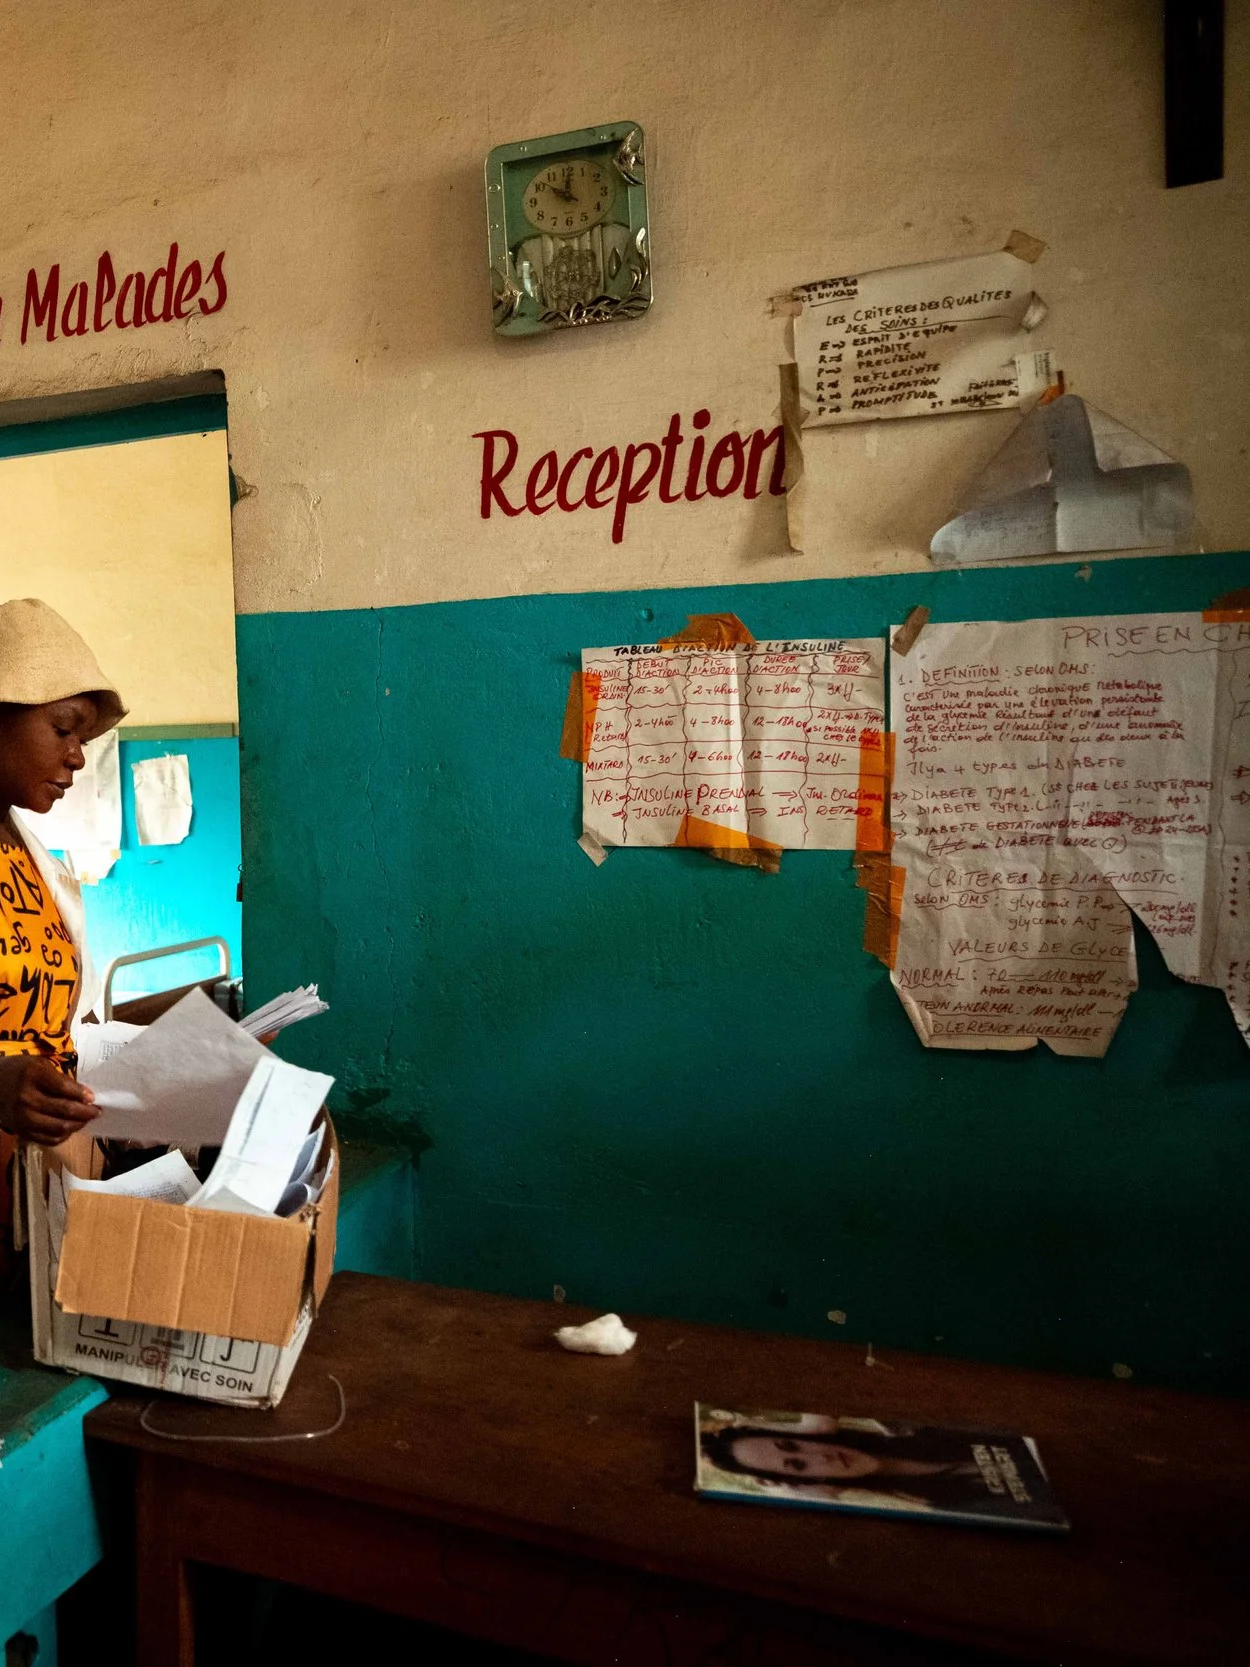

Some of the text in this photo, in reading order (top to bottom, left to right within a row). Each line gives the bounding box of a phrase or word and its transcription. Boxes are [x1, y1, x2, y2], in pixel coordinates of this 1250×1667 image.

[21, 241, 228, 345] Malades
[826, 316, 846, 326] LES
[472, 408, 788, 544] Reception
[614, 646, 662, 656] TABLEAU
[215, 1374, 254, 1393] SOIN
